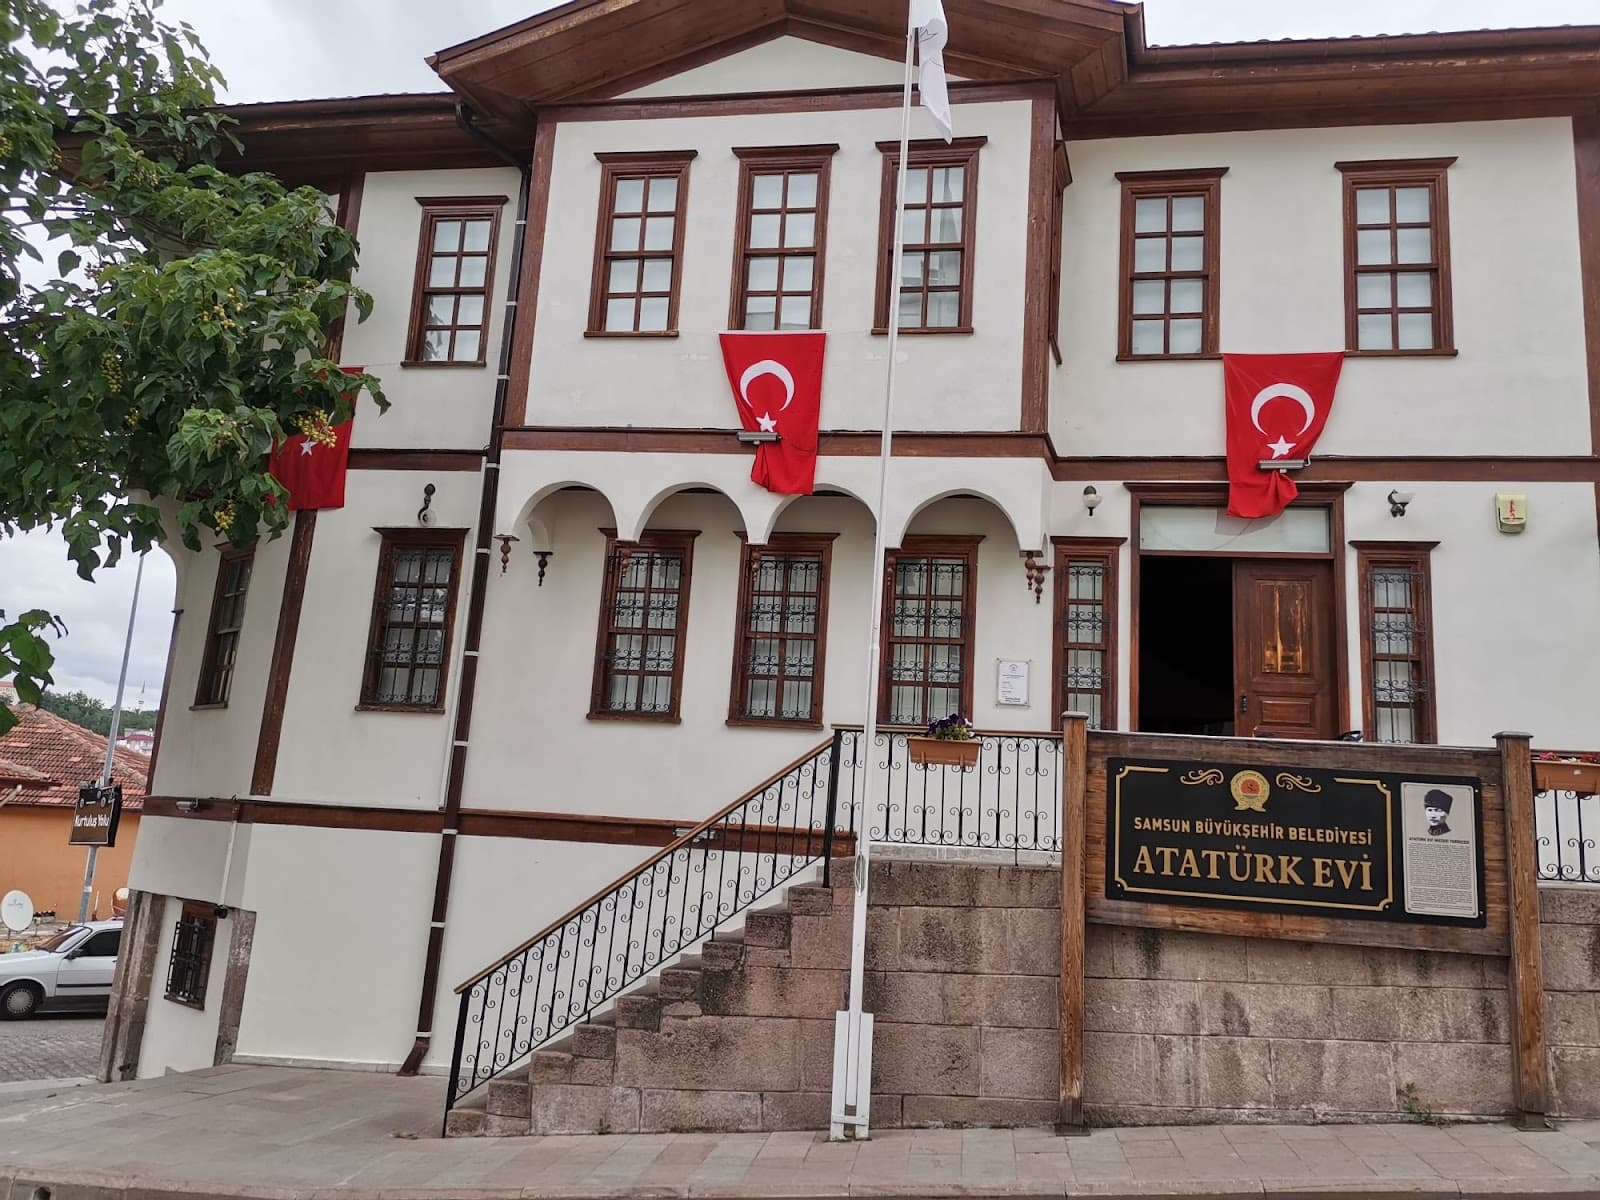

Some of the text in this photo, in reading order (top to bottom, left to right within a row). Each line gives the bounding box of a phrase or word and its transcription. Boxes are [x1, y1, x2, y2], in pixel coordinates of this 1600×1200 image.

[74, 813, 110, 829] Kurtuluş Yolu
[1133, 816, 1373, 846] SAMSUN BÜYÜKŞEHİR BELEDİYESİ
[1132, 844, 1305, 886] ATATÜRK
[1311, 853, 1374, 891] EVİ
